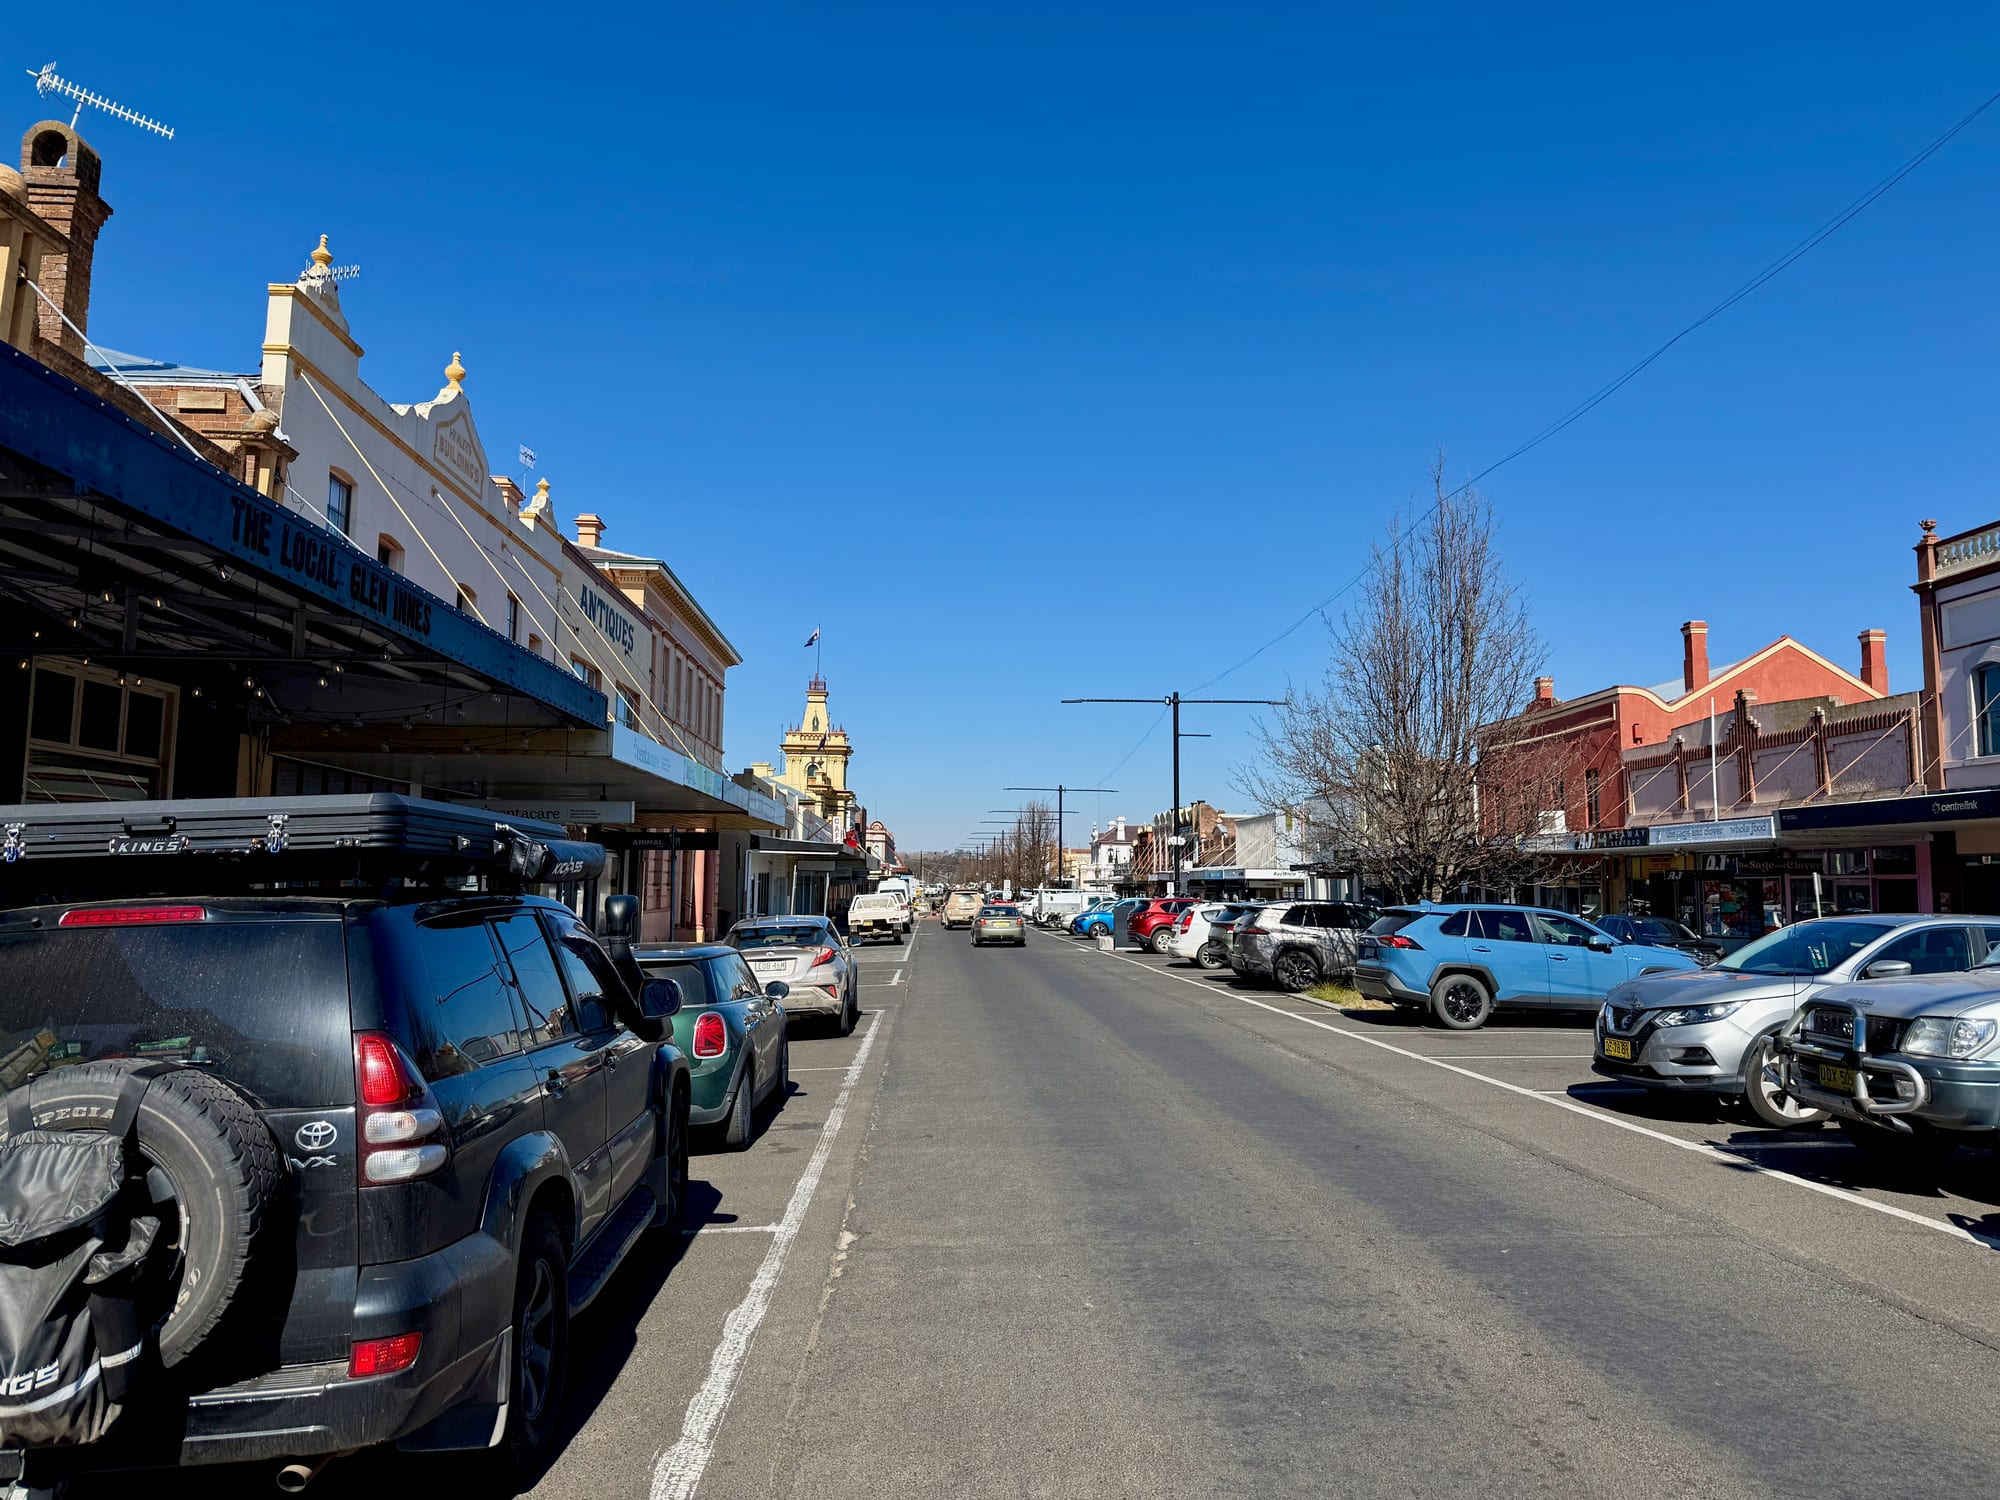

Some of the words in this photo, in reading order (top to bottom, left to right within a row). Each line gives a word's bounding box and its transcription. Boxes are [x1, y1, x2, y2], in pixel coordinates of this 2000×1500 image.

[439, 435, 480, 484] BUILDINGS
[231, 495, 273, 557] THE
[279, 523, 339, 590] LOCAL
[351, 562, 389, 616] GLEN
[392, 584, 432, 637] INNES
[580, 583, 635, 653] ANTIQUES
[492, 808, 561, 819] ntacare
[1940, 800, 1978, 812] centrelink
[118, 841, 180, 853] KINGS
[1749, 860, 1775, 873] Sage
[32, 1106, 113, 1127] PECIA
[289, 1154, 338, 1169] VX
